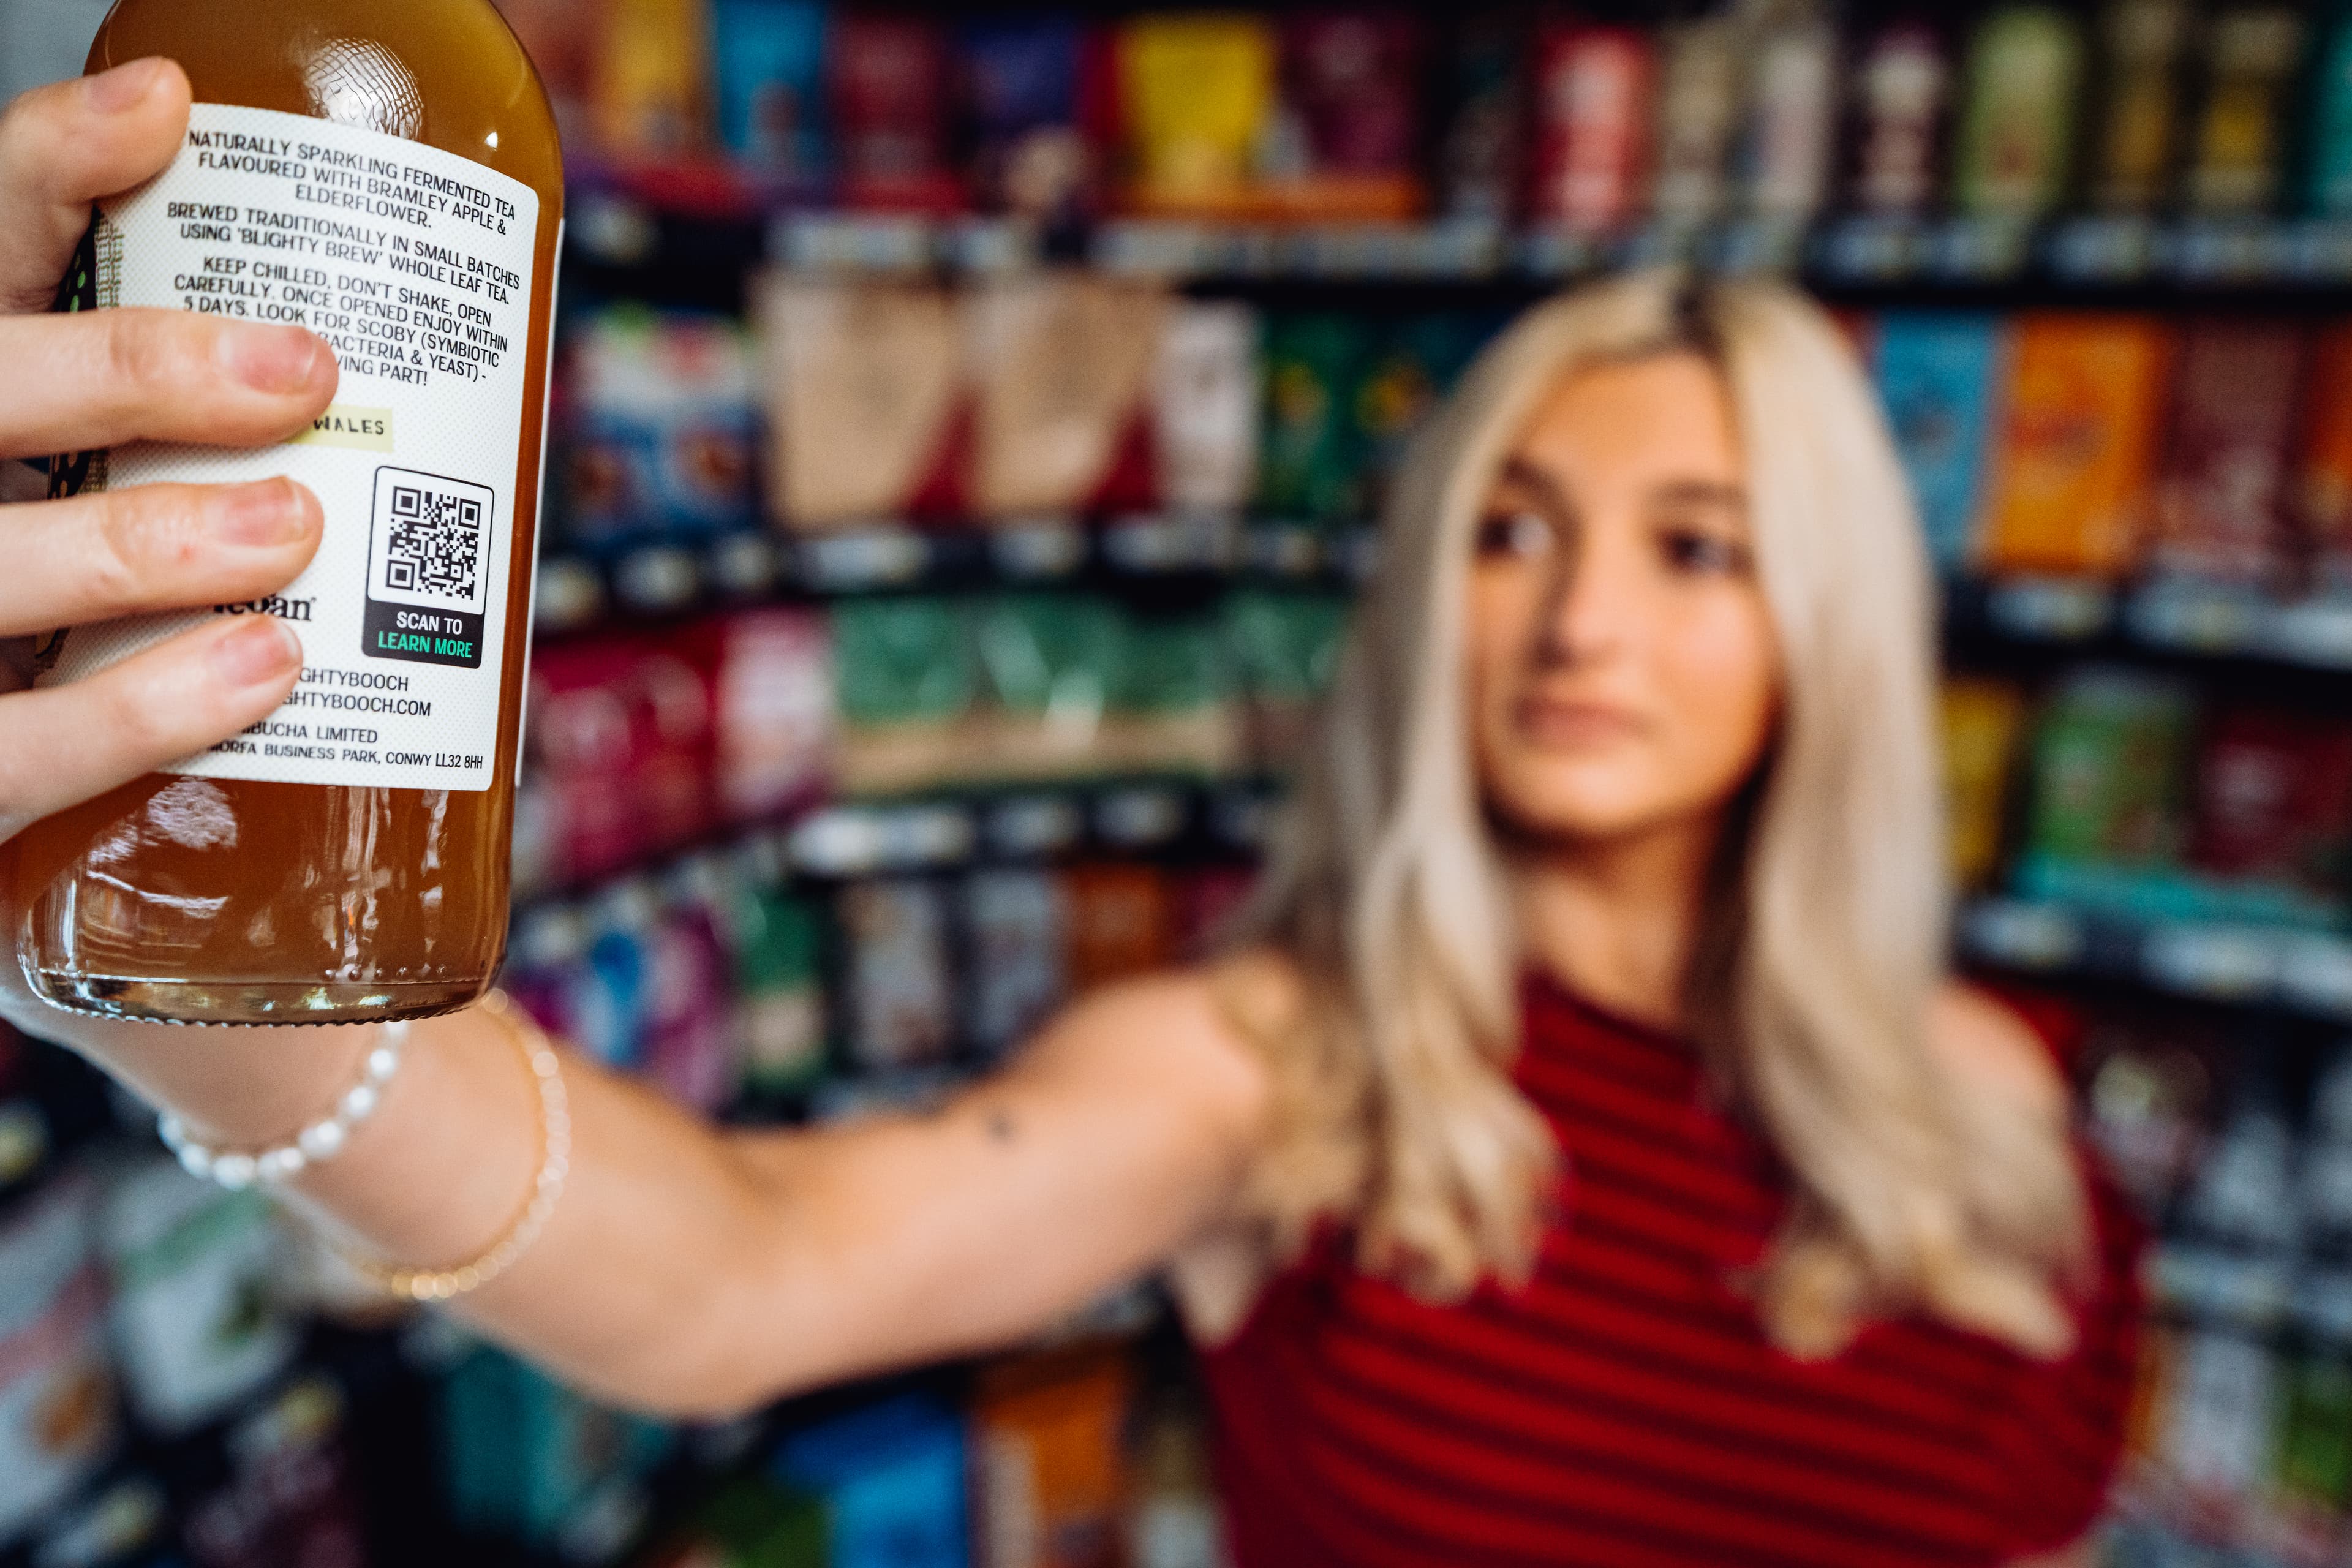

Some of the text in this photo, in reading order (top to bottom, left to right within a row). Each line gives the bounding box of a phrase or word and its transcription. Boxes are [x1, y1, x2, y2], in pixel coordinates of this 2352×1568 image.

[189, 130, 514, 220] NATURALLY SPARKLING FERMENTED TEA
[198, 152, 506, 235] FLAVOURED WITH BRAMLEY APPLE &
[296, 184, 431, 228] ELDERFLOWER.
[167, 202, 519, 290] BREWED TRADITIONALLY IN SMALL BATCHES
[180, 223, 230, 242] USING
[390, 254, 446, 283] WHOLE
[451, 270, 483, 293] LEAF
[486, 282, 509, 304] TEA.
[203, 256, 491, 328] KEEP CHILLED. DON'T SHAKE, OPEN
[184, 295, 499, 368] 5 DAYS. LOOK FOR SCOBY (SYMBIOTIC
[283, 286, 333, 307] ONCE
[341, 295, 408, 322] OPENED
[414, 311, 462, 336] ENJOY
[467, 325, 508, 352] WITHIN
[380, 363, 428, 386] PART!
[411, 350, 423, 366] &
[429, 353, 478, 382] YEAST)
[314, 416, 384, 435] WALES
[396, 611, 462, 635] SCAN TO
[378, 631, 473, 658] LEARN MORE
[299, 667, 409, 691] GHTYBOOCH
[317, 726, 378, 743] LIMITED
[265, 743, 335, 760] BUSINESS
[342, 749, 380, 764] PARK,
[386, 752, 432, 766] CONWY
[435, 753, 461, 768] LL32
[464, 755, 483, 769] 8HH
